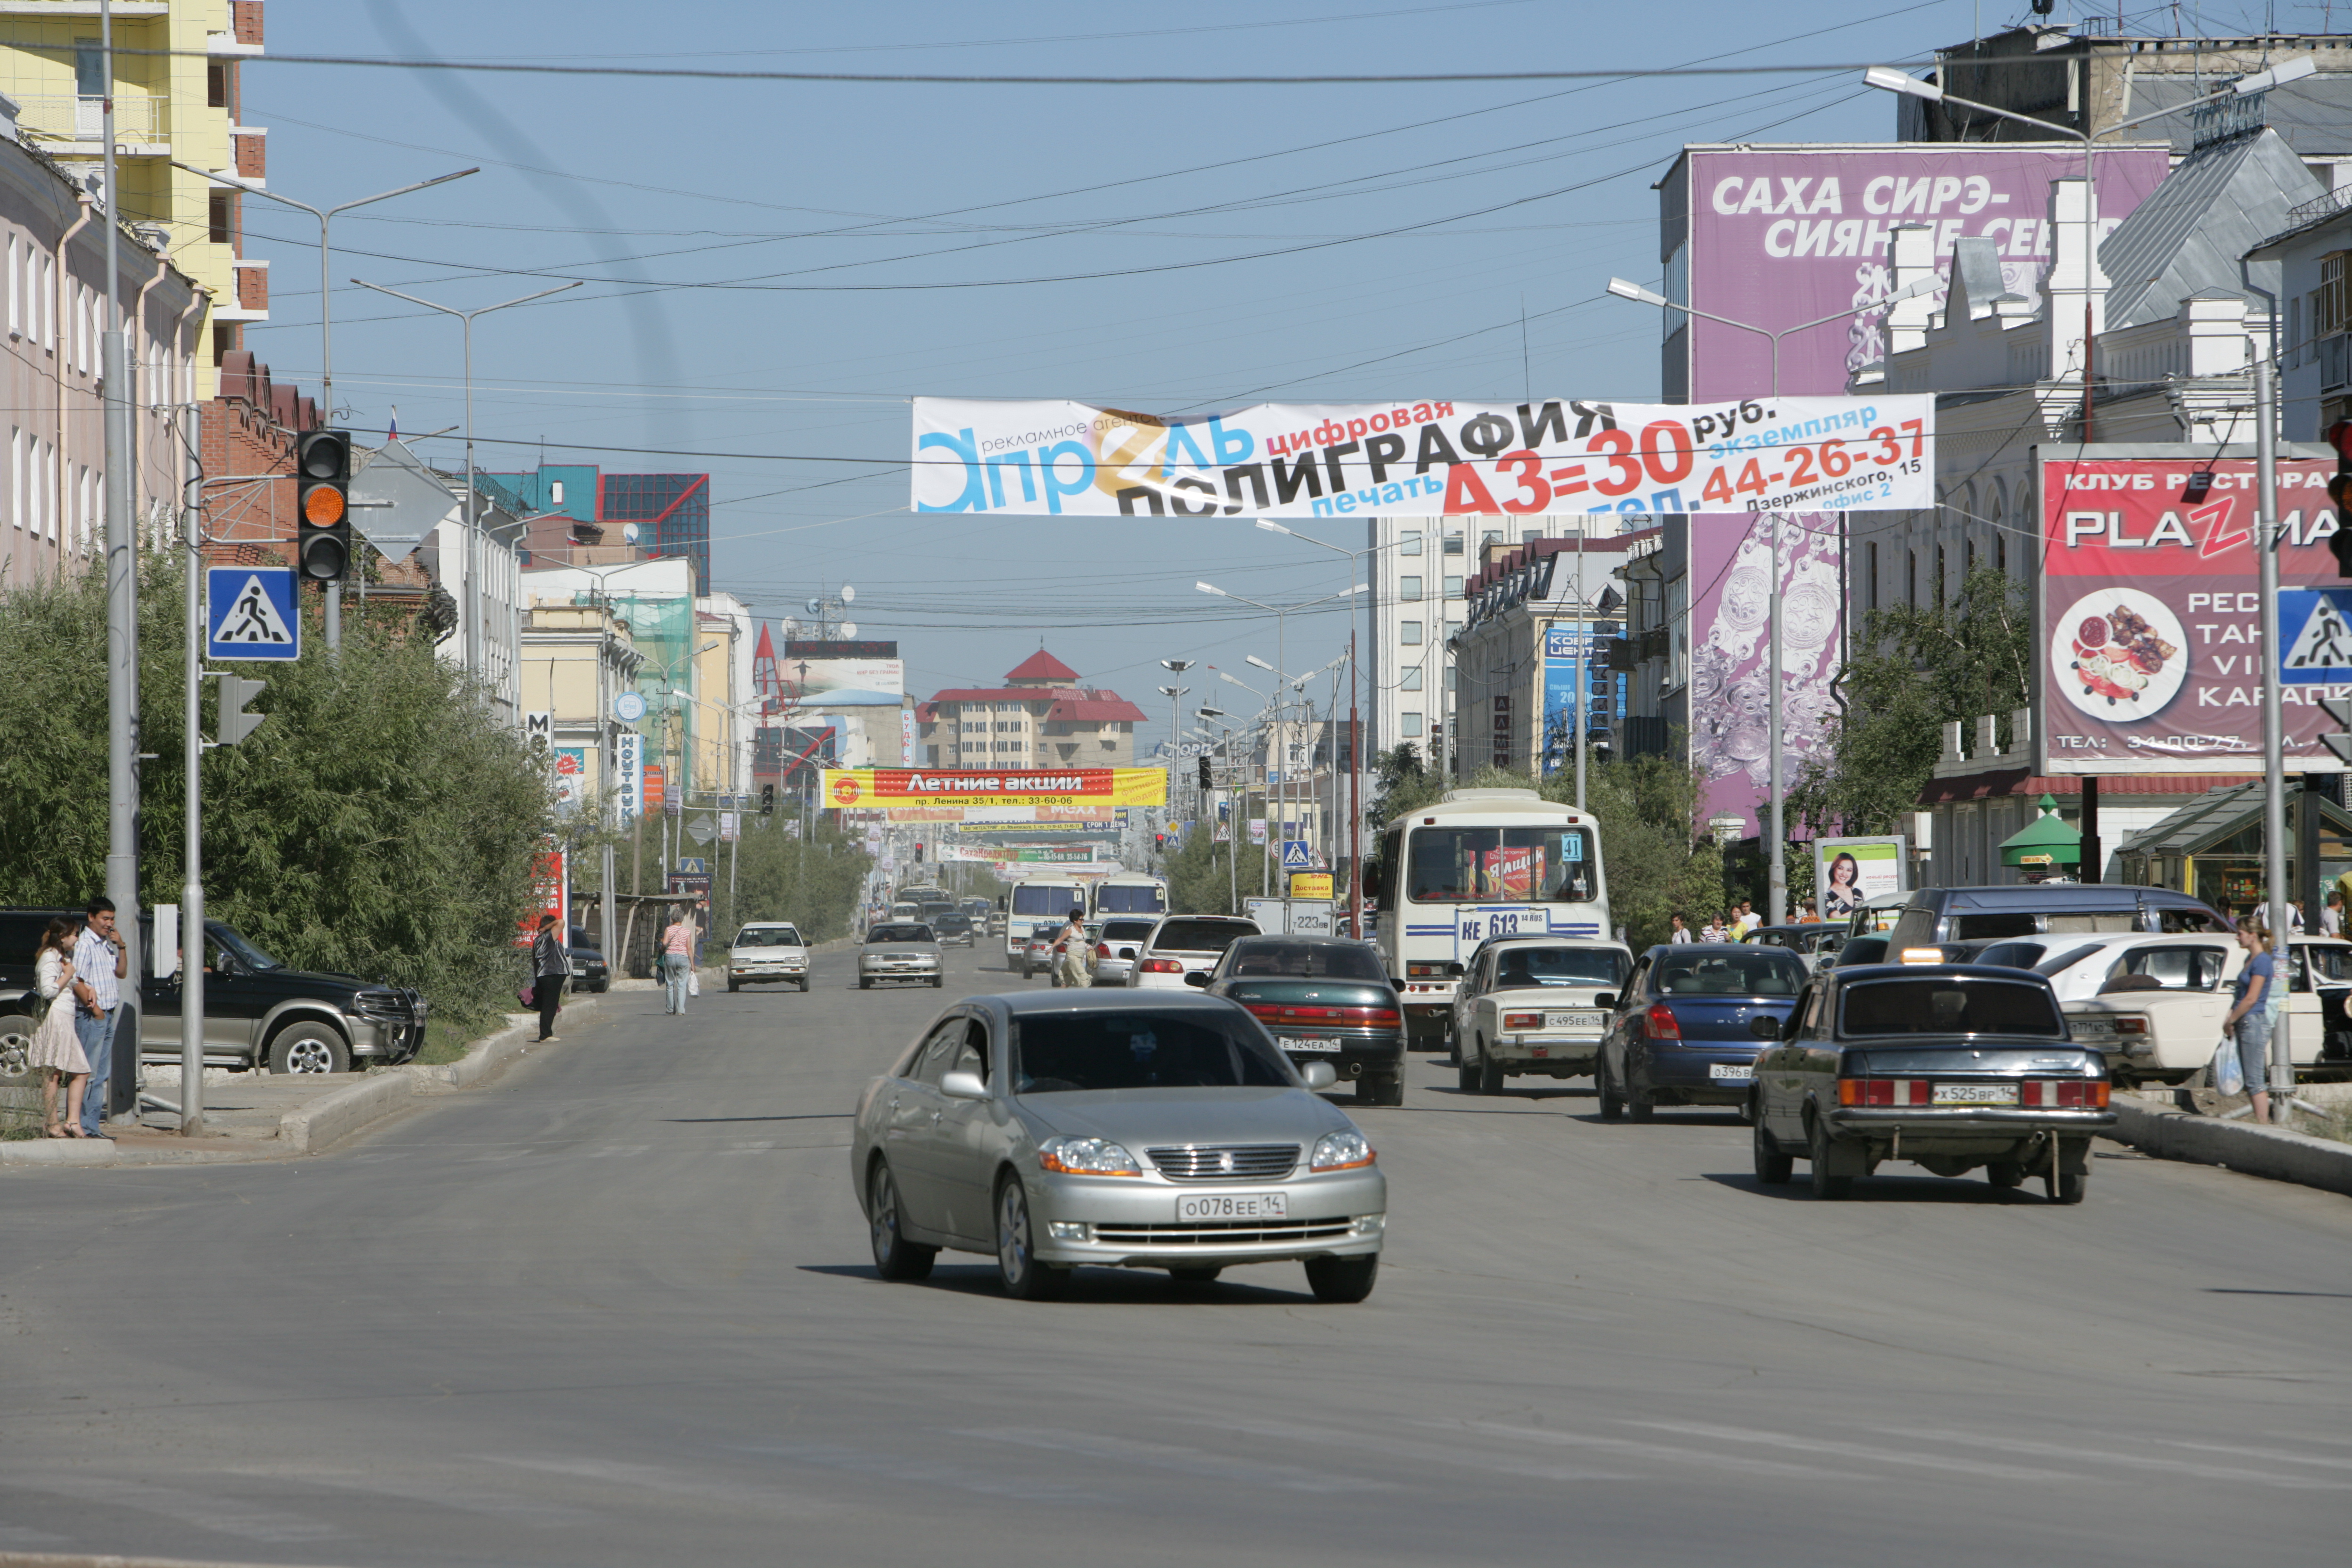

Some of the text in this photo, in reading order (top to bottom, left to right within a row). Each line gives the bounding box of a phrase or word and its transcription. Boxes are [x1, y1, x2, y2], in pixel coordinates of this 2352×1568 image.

[1712, 176, 2010, 215] САХА СИРЭ-
[1764, 218, 1962, 258] СИЯНЕ
[1266, 401, 1454, 458] цифровая
[1692, 400, 1776, 444] руб.
[1708, 406, 1878, 460] экземпляр
[981, 422, 1087, 455] рекламное
[1116, 401, 1617, 518] ПОЛИГРАФИЯ
[1702, 417, 1923, 504] 44-26-37
[1746, 458, 1921, 512] Дзержинского, 15
[2065, 473, 2155, 490] КЛУБ
[1311, 475, 1444, 518] печать
[1822, 482, 1892, 510] офис 2
[2066, 496, 2341, 559] PLAZMA
[2189, 593, 2260, 612] РЕС
[2057, 736, 2107, 748] ТЕЛ:
[906, 774, 1083, 792] Летние акции
[1117, 768, 1158, 786] 1 месяц
[1121, 776, 1162, 798] фитнеса
[972, 797, 998, 805] 35/1,
[1564, 839, 1579, 856] 41
[1462, 914, 1518, 940] КЕ 613
[1327, 1038, 1338, 1047] 14
[2000, 1087, 2012, 1096] 14
[1263, 1196, 1280, 1210] 14
